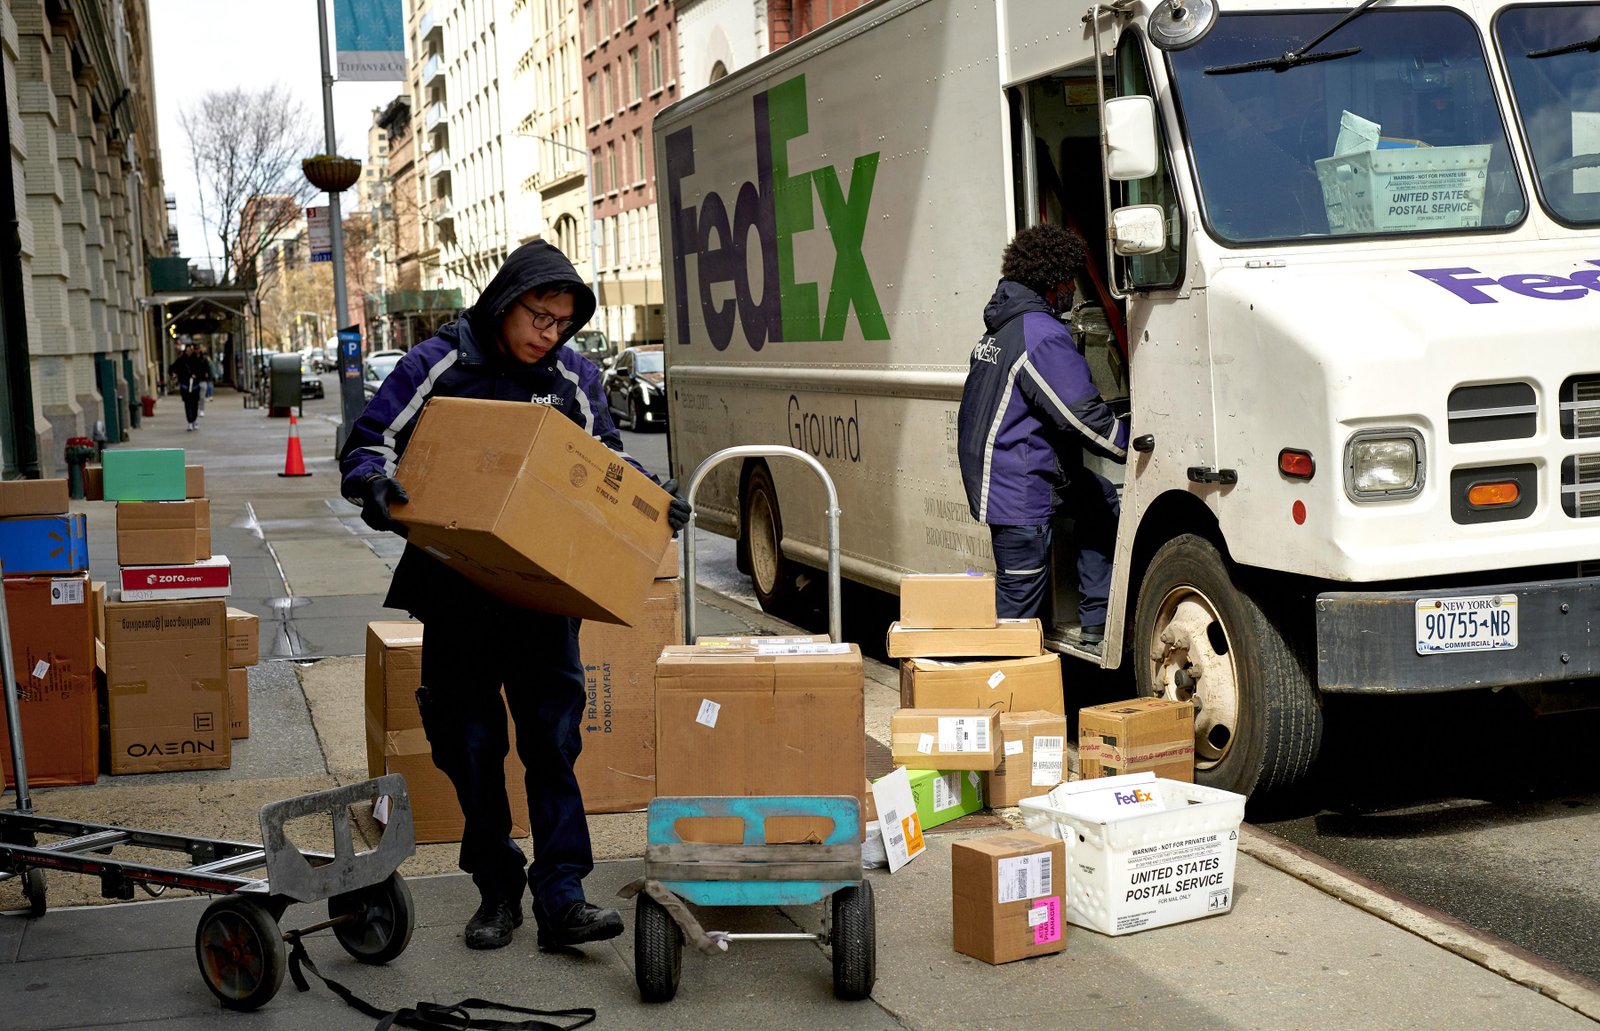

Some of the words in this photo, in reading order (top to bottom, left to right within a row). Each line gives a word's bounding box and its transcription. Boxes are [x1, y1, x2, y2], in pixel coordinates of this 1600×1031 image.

[1392, 192, 1429, 203] UNITED
[1431, 190, 1469, 201] STATES
[665, 73, 891, 352] FedEx
[1388, 204, 1429, 216] POSTAL
[1431, 202, 1474, 213] SERVICE
[531, 393, 564, 406] FedEx
[788, 394, 860, 462] Ground
[936, 498, 970, 525] MASPETH
[159, 574, 201, 583] zoro.com
[1442, 601, 1465, 611] NEW
[1467, 600, 1492, 610] YORK
[1426, 611, 1478, 640] 90755
[1490, 610, 1510, 637] NB
[1444, 640, 1490, 649] COMMERCIAL
[602, 662, 611, 681] FLAT
[588, 678, 597, 719] FRAGILE
[603, 684, 612, 698] LAY
[603, 700, 612, 718] NOT
[604, 719, 612, 733] DO
[1114, 789, 1153, 806] FedEx
[1132, 846, 1157, 856] WARNING
[1161, 842, 1172, 851] NOT
[1172, 840, 1184, 848] FOR
[1184, 836, 1205, 847] PRIVATE
[1206, 834, 1217, 842] USE
[1130, 866, 1173, 885] UNITED
[1175, 857, 1220, 876] STATES
[1125, 883, 1172, 903] POSTAL
[1175, 872, 1224, 892] SERVICE
